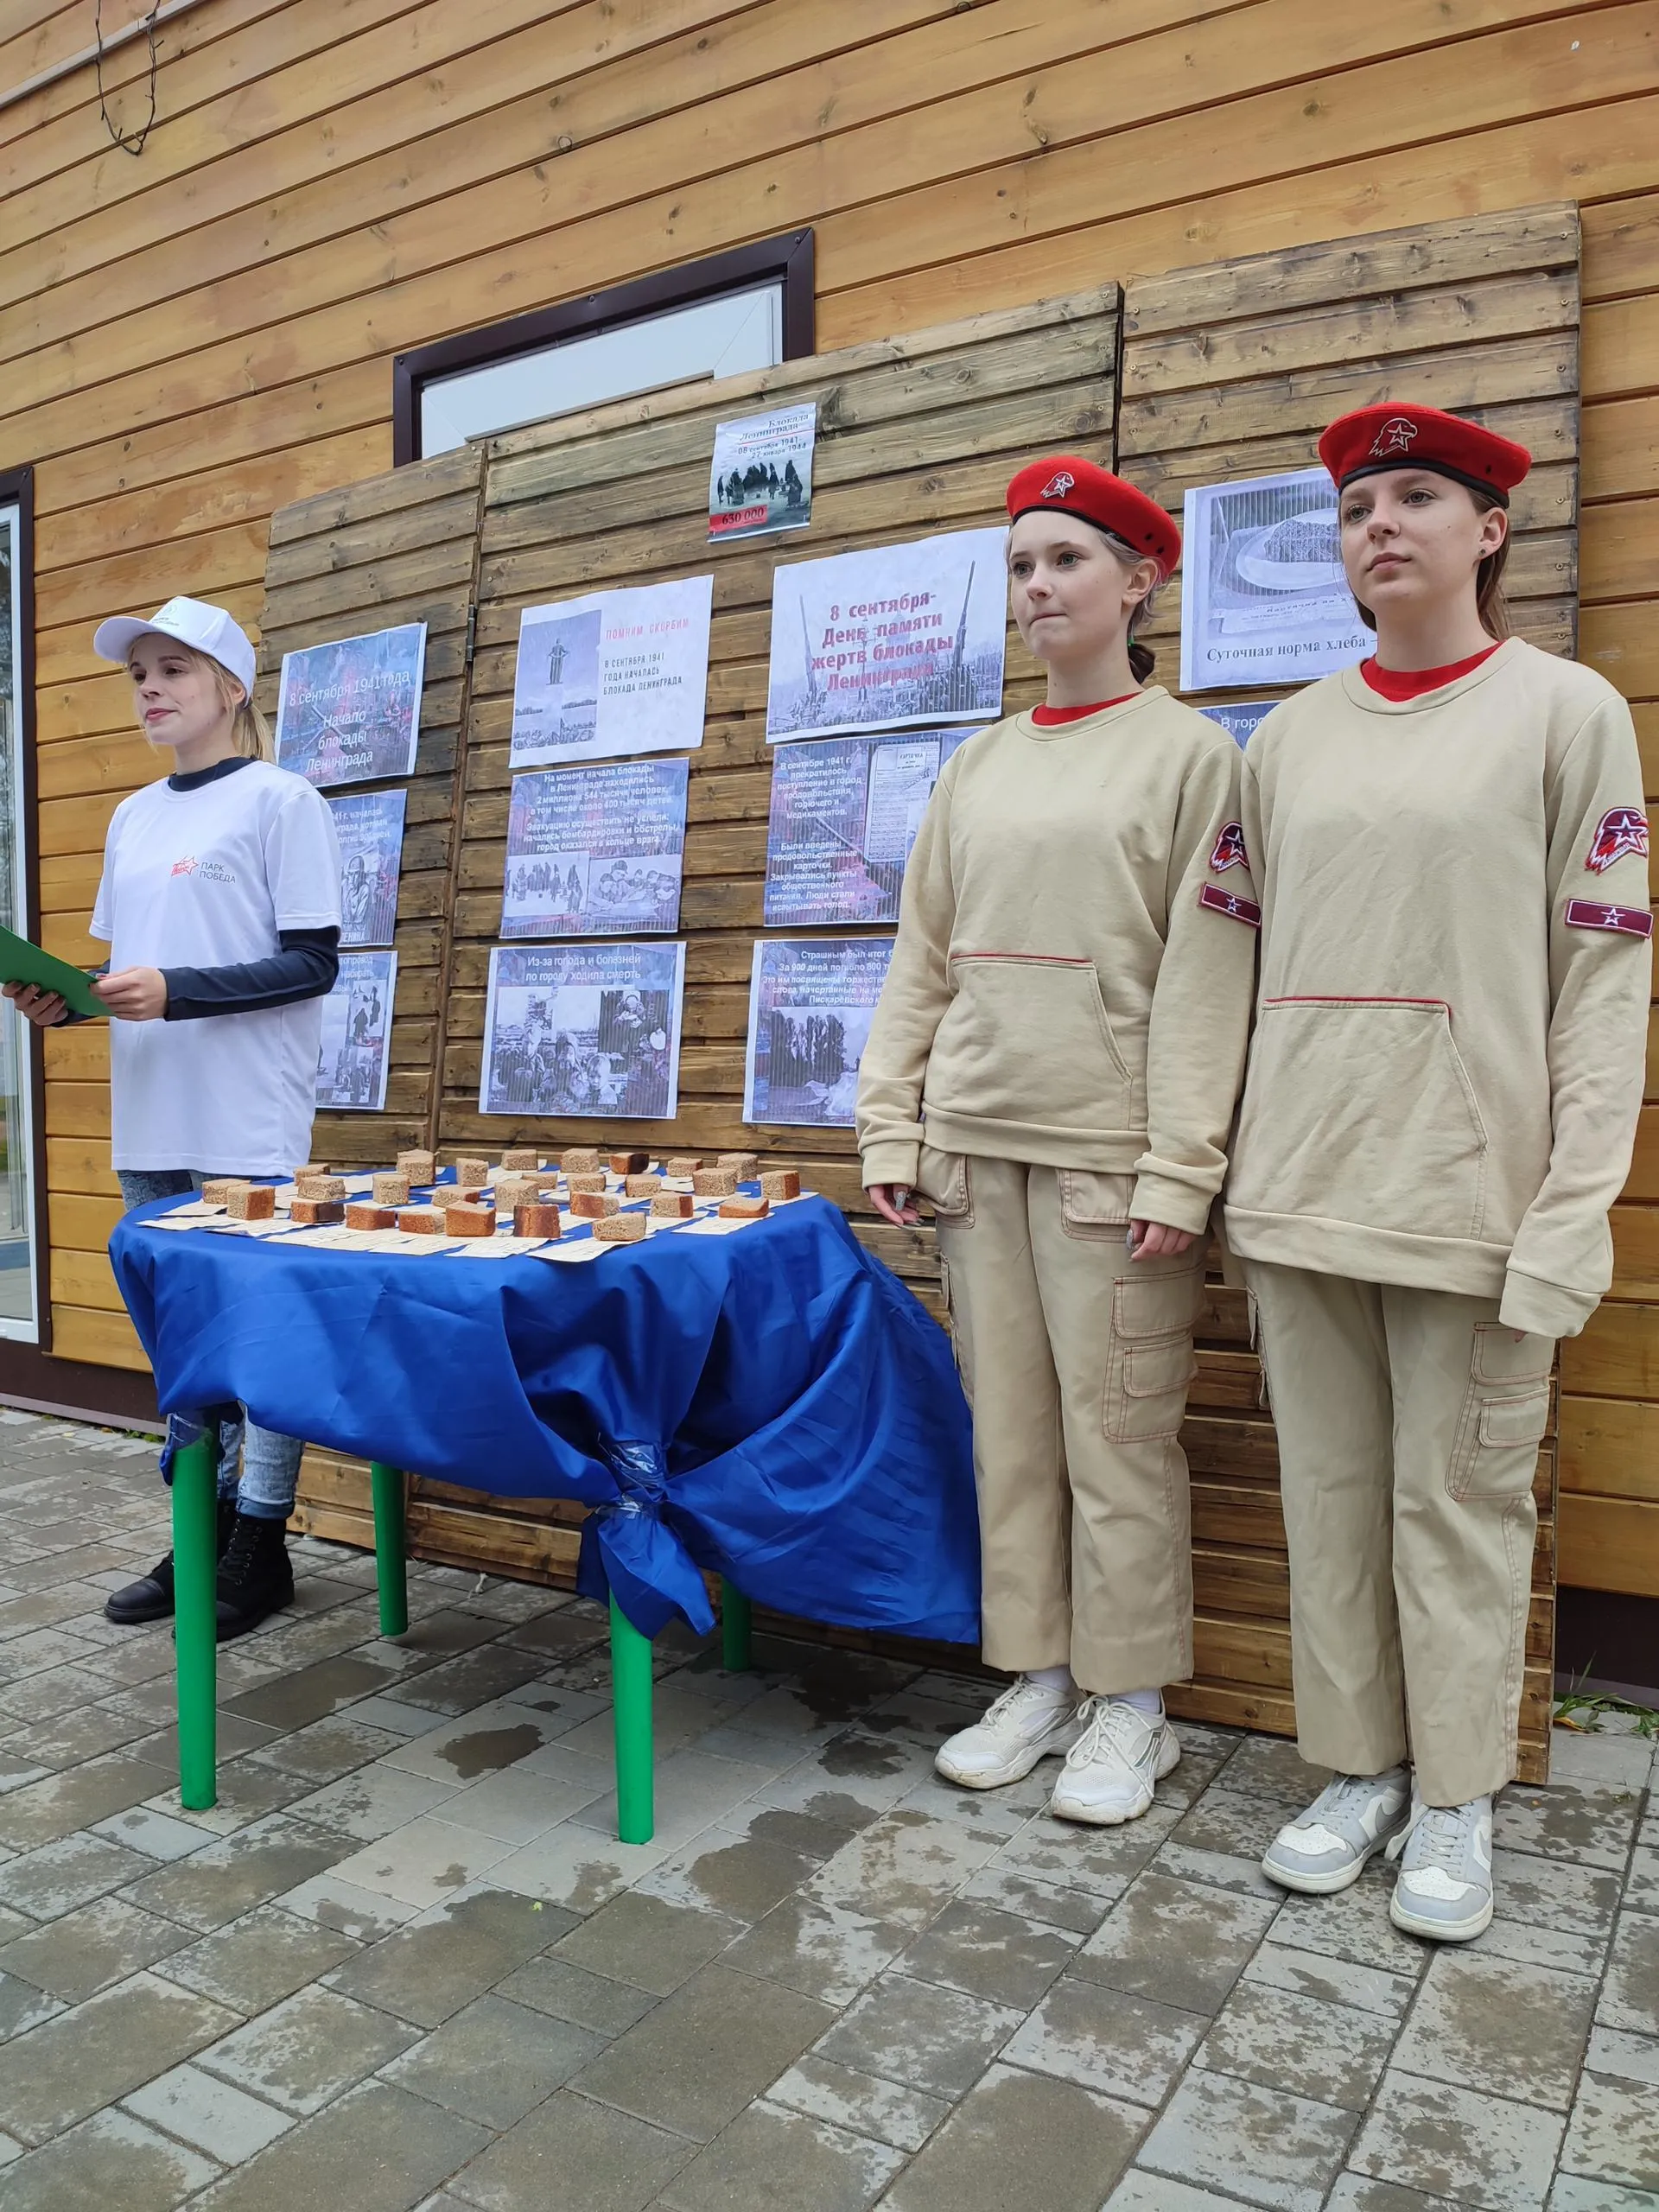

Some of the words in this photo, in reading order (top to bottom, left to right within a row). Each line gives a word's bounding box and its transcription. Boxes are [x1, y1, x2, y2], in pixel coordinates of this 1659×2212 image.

[768, 415, 809, 428] Блокада
[740, 423, 798, 441] Ленинграда
[721, 512, 741, 524] 630
[744, 507, 765, 519] 000
[830, 606, 840, 621] 8
[606, 626, 643, 640] ПОМНИМ
[649, 618, 690, 634] СКОРБИМ
[822, 626, 867, 649] День
[877, 613, 943, 636] памяти
[810, 650, 867, 672] жертв
[873, 635, 954, 661] блокады
[1206, 648, 1273, 664] Суточная
[1277, 642, 1321, 658] норма
[1325, 636, 1366, 651] хлеба
[612, 655, 645, 668] СЕНТЯБРЯ
[649, 652, 664, 662] 1941
[604, 672, 622, 682] ГОДА
[625, 667, 660, 679] НАЧАЛАСЬ
[827, 660, 934, 691] Ленинграда
[289, 694, 296, 707] 8
[299, 683, 350, 705] сентября
[354, 676, 381, 693] 1941
[382, 670, 410, 688] года
[603, 683, 636, 696] БЛОКАДА
[639, 676, 683, 690] ЛЕНИНГРАДА
[322, 709, 366, 729] Начало
[1221, 717, 1230, 729] В
[318, 731, 367, 750] блокады
[305, 750, 373, 772] Ленинграда
[827, 756, 843, 766] 1941
[587, 768, 616, 779] начала
[617, 765, 655, 776] блокады
[791, 767, 847, 779] прекратилось
[794, 799, 833, 810] горючего
[537, 842, 560, 853] город
[781, 842, 804, 851] Были
[200, 862, 225, 872] ПАРК
[199, 871, 236, 883] ПОБЕДА
[527, 956, 552, 966] Из-за
[554, 955, 586, 966] голода
[588, 956, 594, 964] и
[596, 953, 640, 965] болезней
[801, 950, 846, 960] Страшным
[525, 973, 537, 982] по
[539, 971, 568, 983] городу
[571, 970, 605, 981] ходила
[607, 970, 640, 982] смерть
